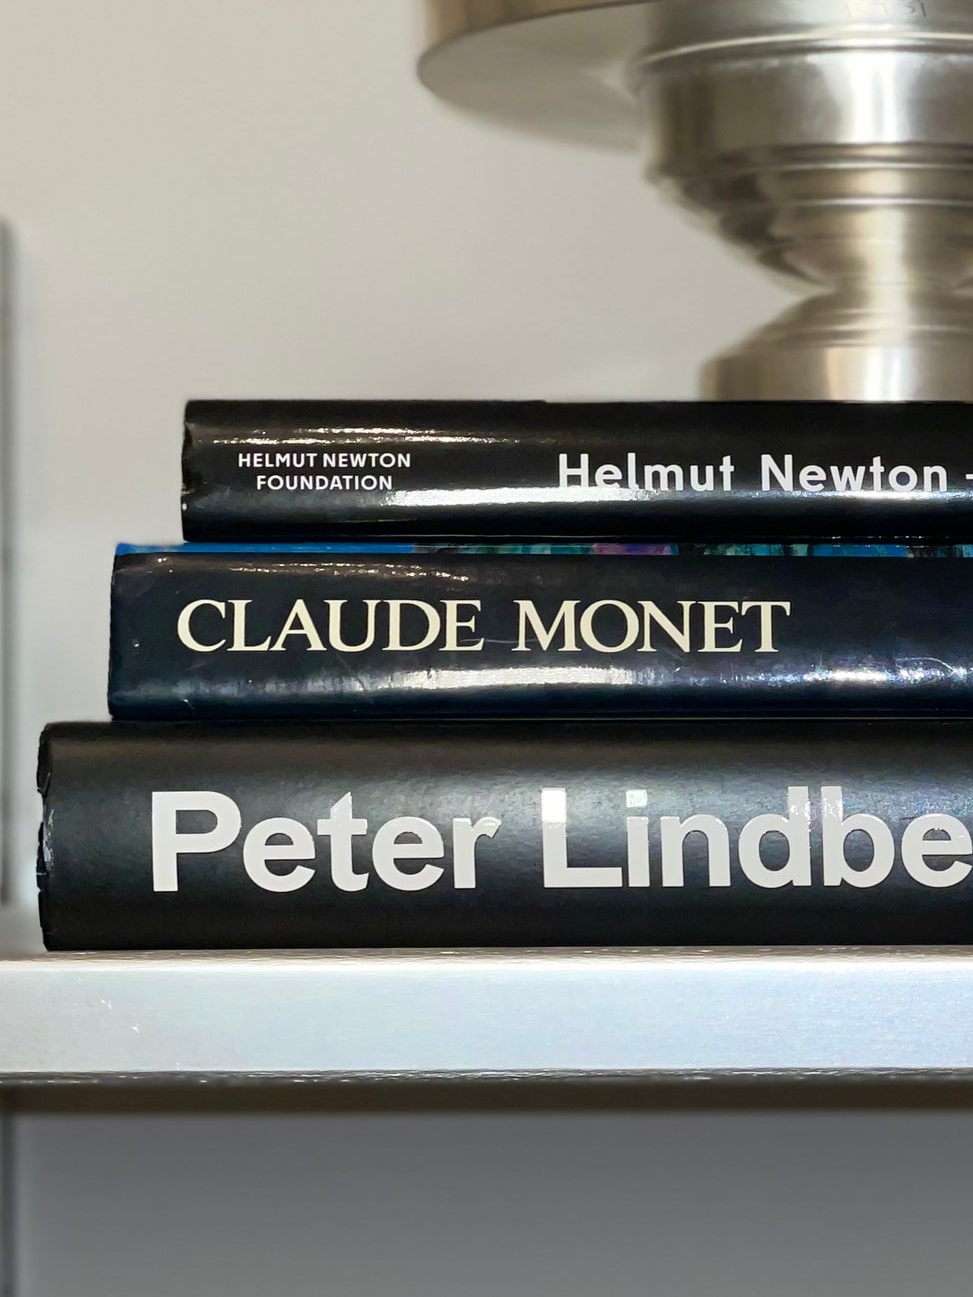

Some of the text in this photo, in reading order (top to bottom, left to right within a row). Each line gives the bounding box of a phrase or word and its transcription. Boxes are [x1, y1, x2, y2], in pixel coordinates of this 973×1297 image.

[238, 452, 411, 468] HELMUT NEWTON
[558, 453, 735, 492] Helmut
[761, 454, 948, 493] Newton
[256, 474, 394, 491] FOUNDATION
[177, 598, 791, 653] CLAUDE MONET
[150, 790, 502, 893] Peter
